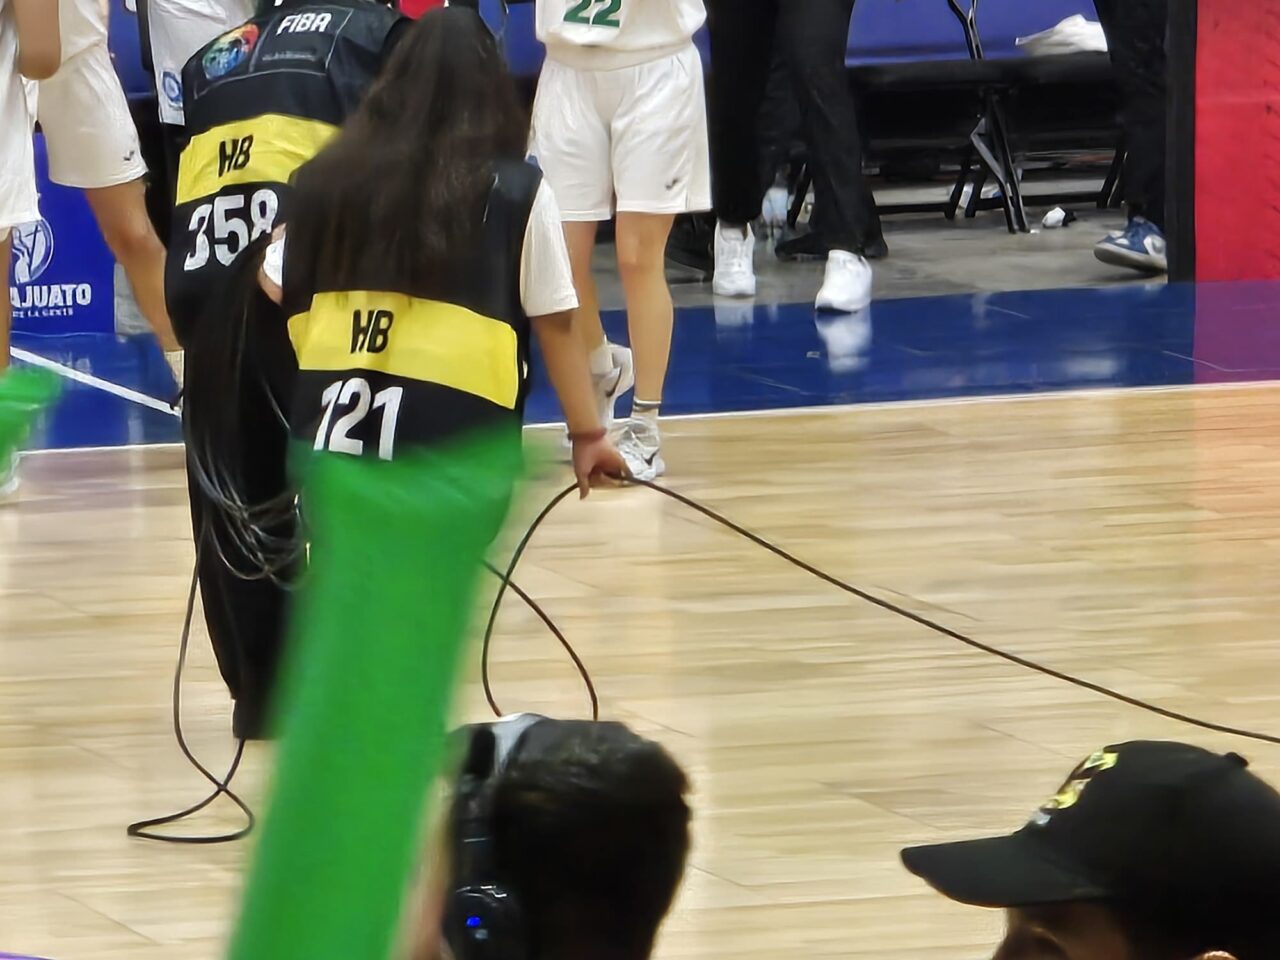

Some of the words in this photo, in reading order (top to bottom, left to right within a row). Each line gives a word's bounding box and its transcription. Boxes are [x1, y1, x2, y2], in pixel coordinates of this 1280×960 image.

[276, 12, 332, 36] FIBA
[218, 134, 253, 178] HB
[183, 188, 279, 272] 358
[9, 283, 92, 308] AJUATO
[350, 309, 394, 354] HB
[313, 377, 403, 461] 121
